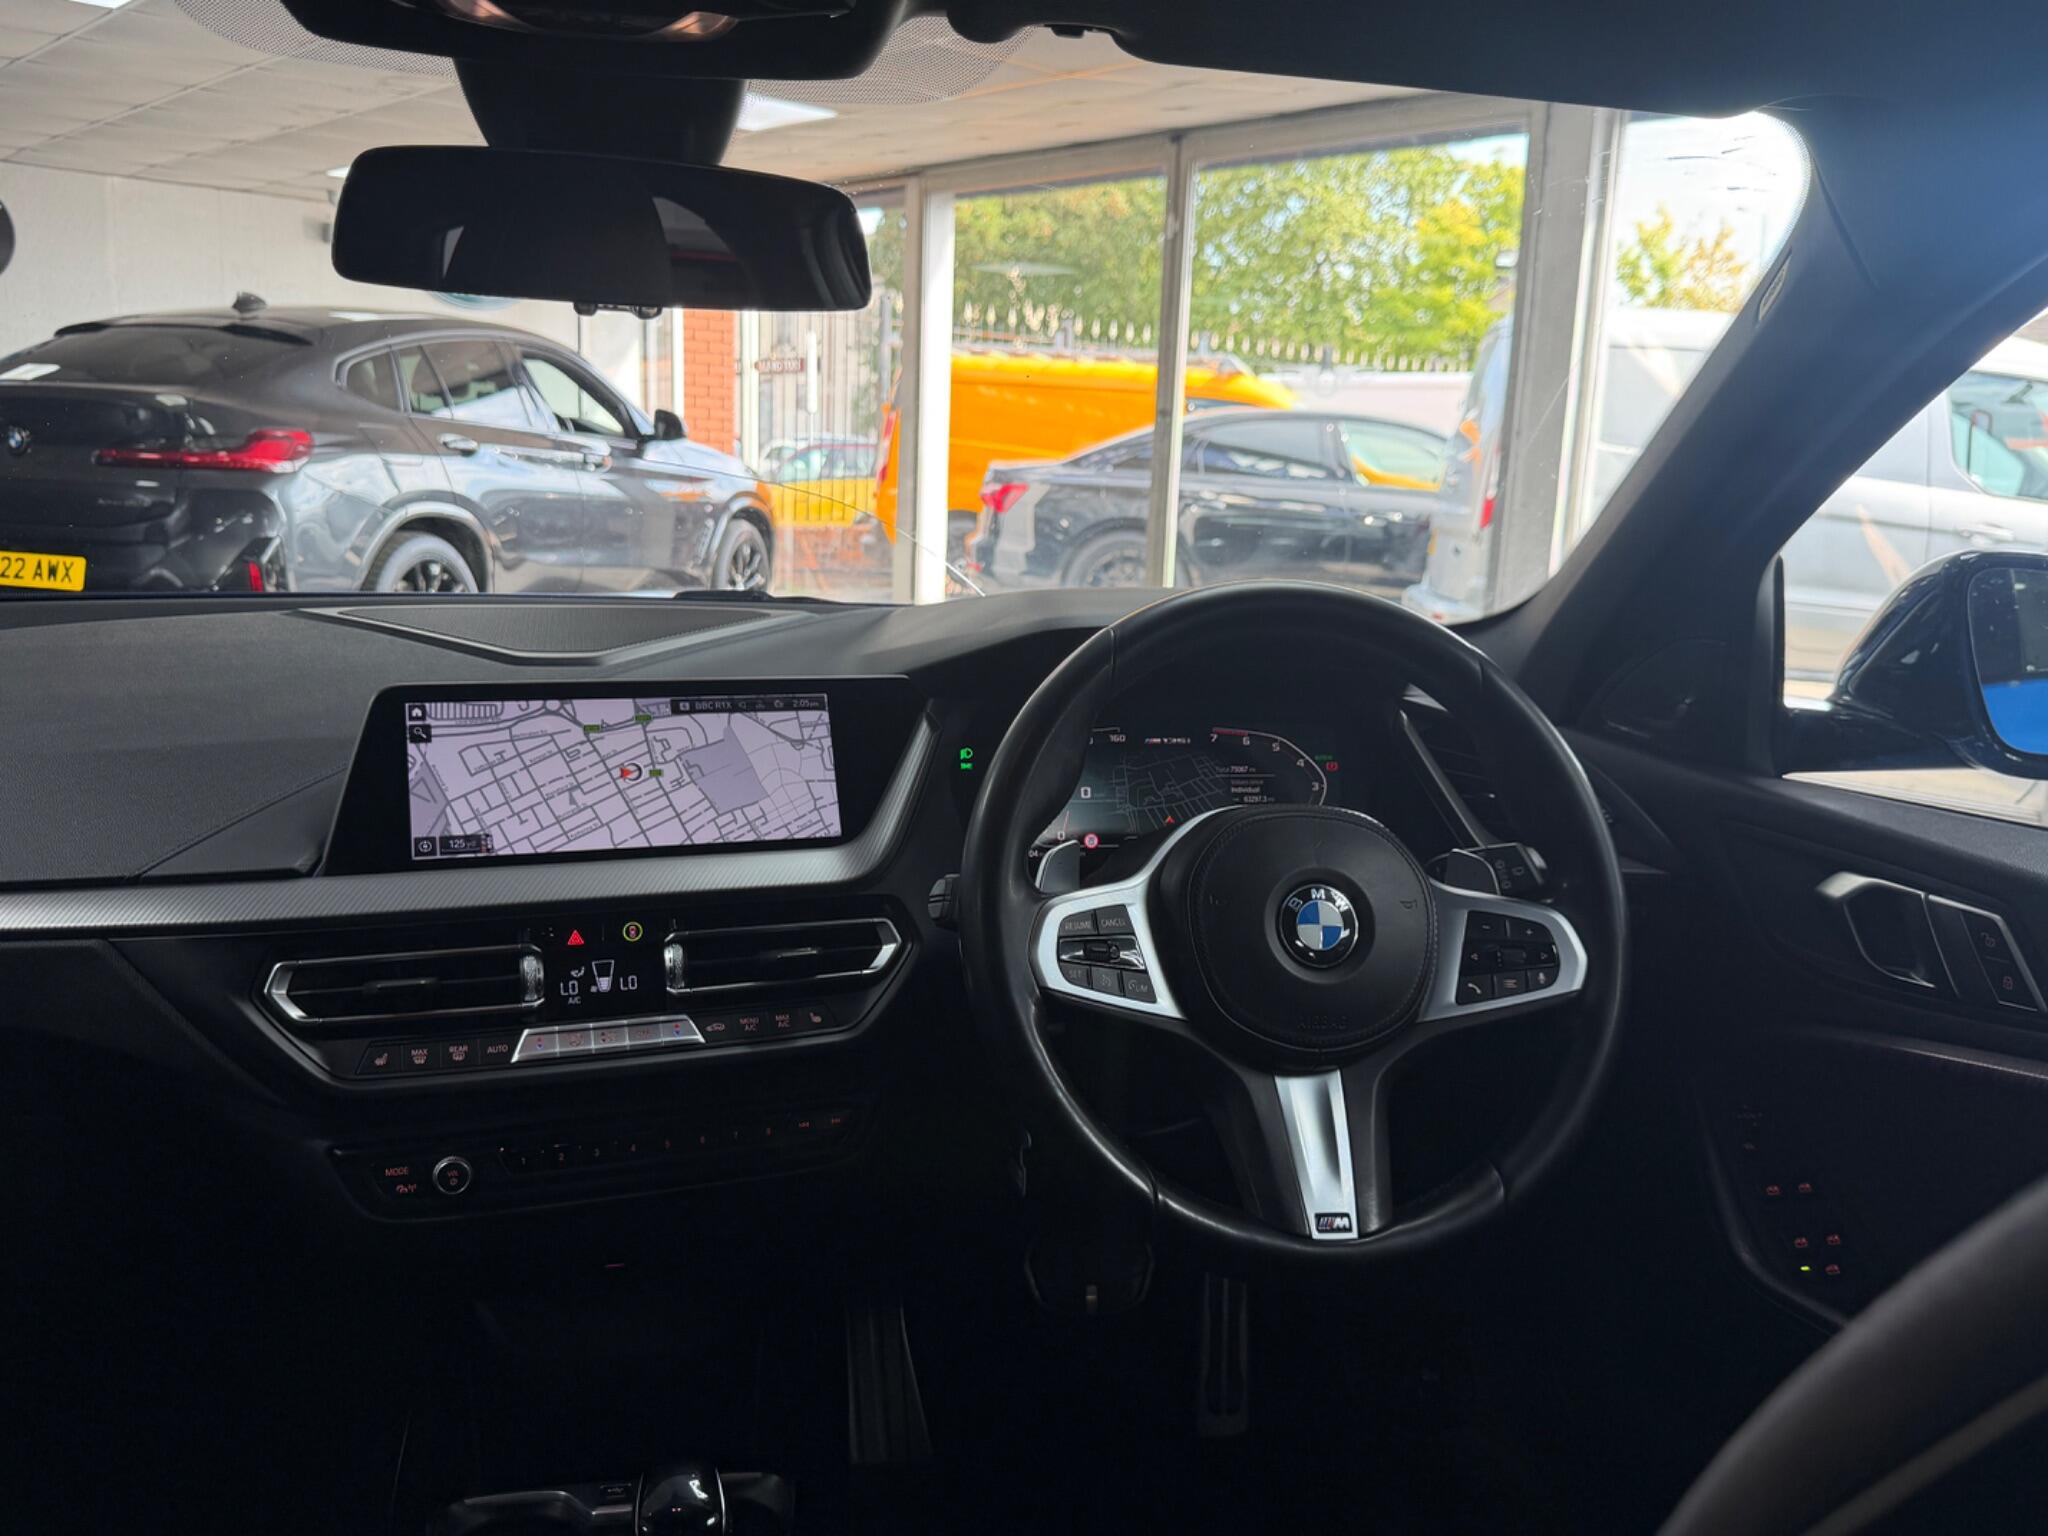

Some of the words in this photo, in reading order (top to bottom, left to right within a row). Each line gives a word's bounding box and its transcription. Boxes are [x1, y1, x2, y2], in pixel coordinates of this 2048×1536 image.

[33, 559, 74, 584] AWX
[1109, 734, 1126, 743] 160
[1209, 733, 1219, 743] 7
[1242, 736, 1250, 746] 6
[1272, 742, 1280, 752] 5
[1296, 758, 1305, 768] 4
[1311, 782, 1319, 791] 3
[449, 839, 466, 848] 125
[1288, 888, 1350, 913] BMW
[560, 980, 579, 996] LO
[620, 975, 638, 991] LO
[411, 1048, 429, 1056] MAX
[486, 1044, 509, 1055] AUTO
[385, 1166, 410, 1178] MODE
